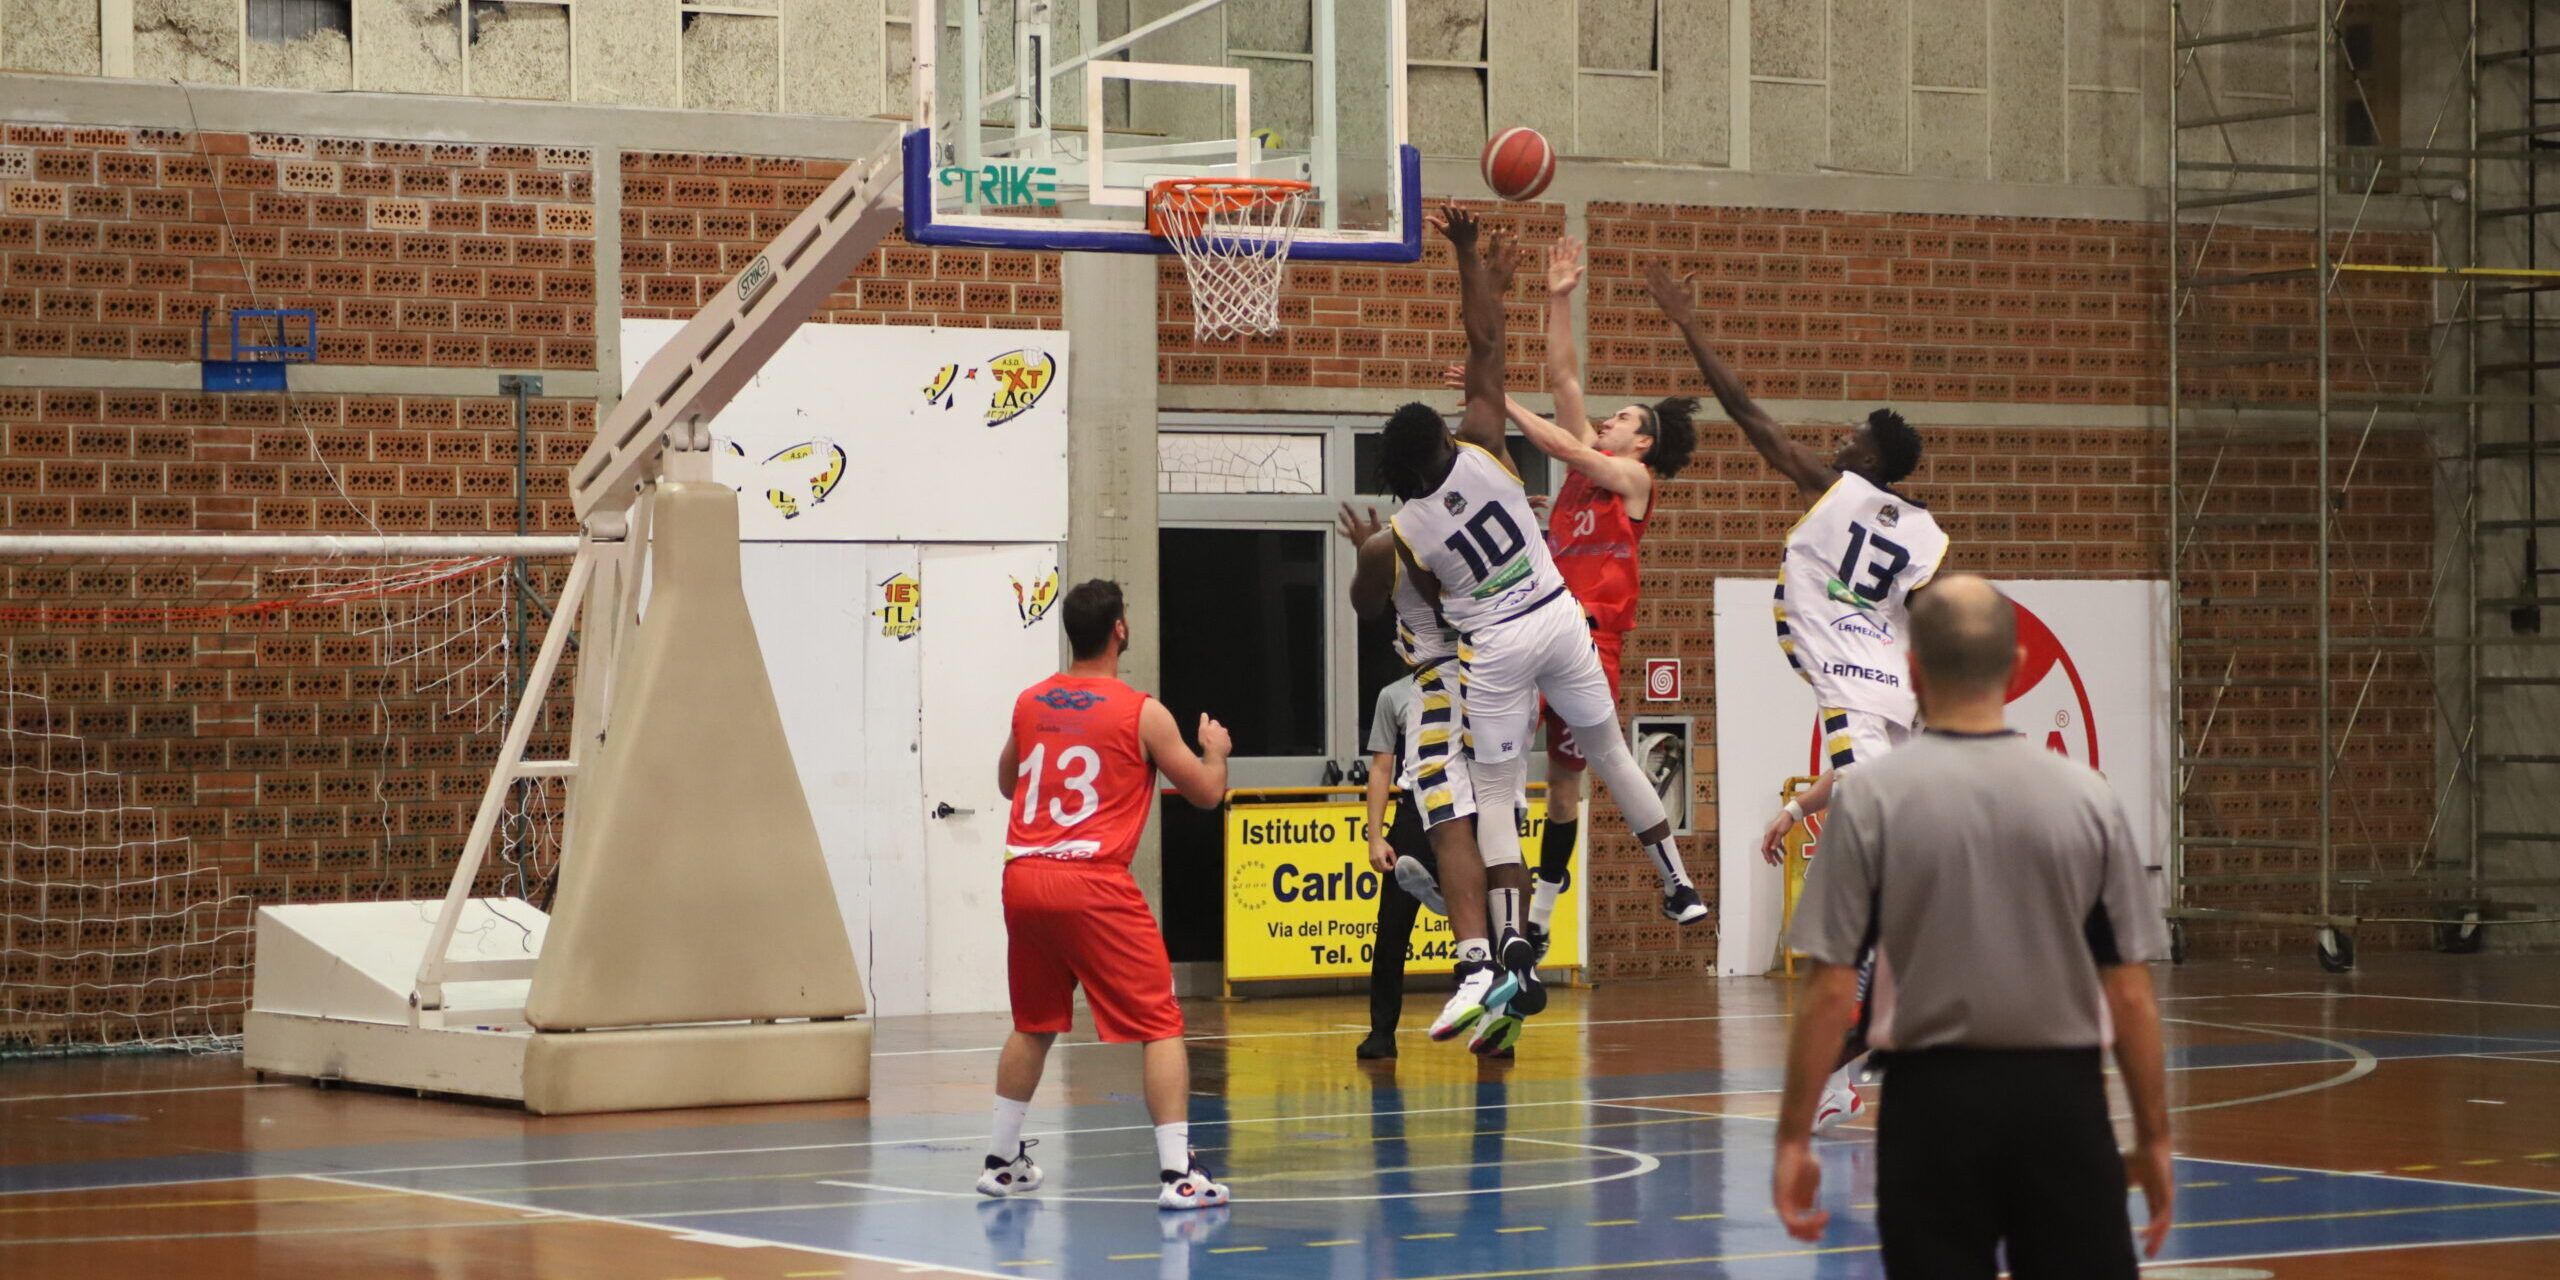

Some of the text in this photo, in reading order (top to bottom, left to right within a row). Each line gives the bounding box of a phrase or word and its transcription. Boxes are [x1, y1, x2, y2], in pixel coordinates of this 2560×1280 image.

[741, 260, 766, 297] STRIKE
[1573, 509, 1595, 538] 20
[1444, 500, 1526, 584] 10
[1839, 520, 1910, 602] 13
[1823, 661, 1899, 688] LAMEZIA
[1018, 742, 1101, 827] 13
[1243, 818, 1336, 845] Istituto
[1272, 862, 1379, 904] Carlo
[1267, 922, 1293, 938] Via
[1298, 920, 1322, 937] del
[1328, 920, 1379, 939] Progre
[1311, 945, 1352, 965] Tel.
